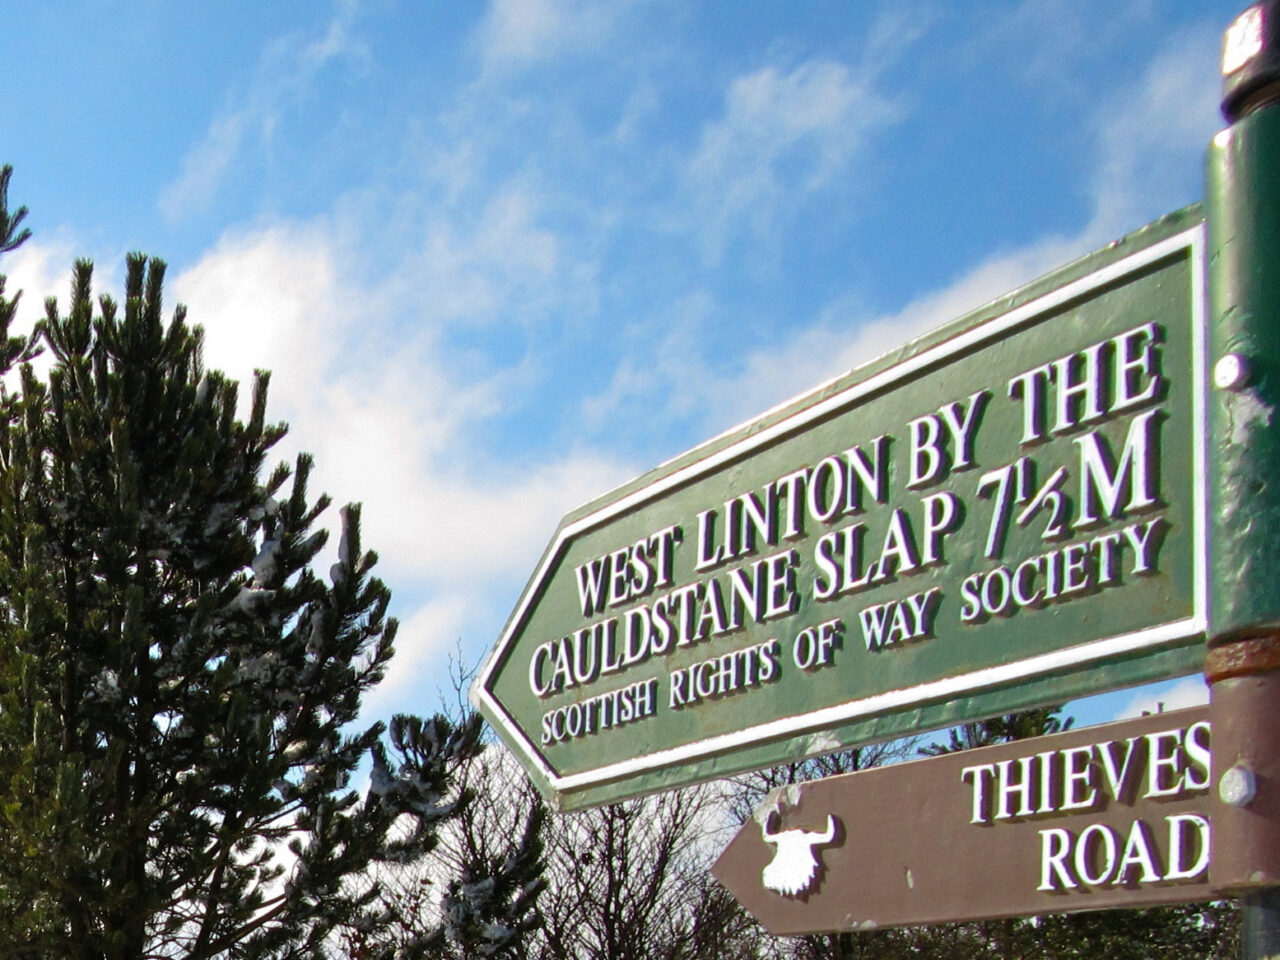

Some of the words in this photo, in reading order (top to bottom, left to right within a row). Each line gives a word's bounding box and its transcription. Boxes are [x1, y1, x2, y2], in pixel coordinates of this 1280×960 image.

[575, 523, 681, 616] WEST
[694, 433, 891, 570] LINTON
[906, 388, 990, 489] BY
[1007, 321, 1161, 445] THE
[528, 548, 799, 697] CAULDSTANE
[813, 491, 956, 600] SLAP
[540, 677, 657, 745] SCOTTISH
[669, 638, 778, 709] RIGHTS
[793, 617, 843, 669] OF
[858, 586, 940, 650] WAY
[960, 516, 1166, 621] SOCIETY
[961, 721, 1211, 824] THIEVES
[1036, 814, 1211, 891] ROAD
